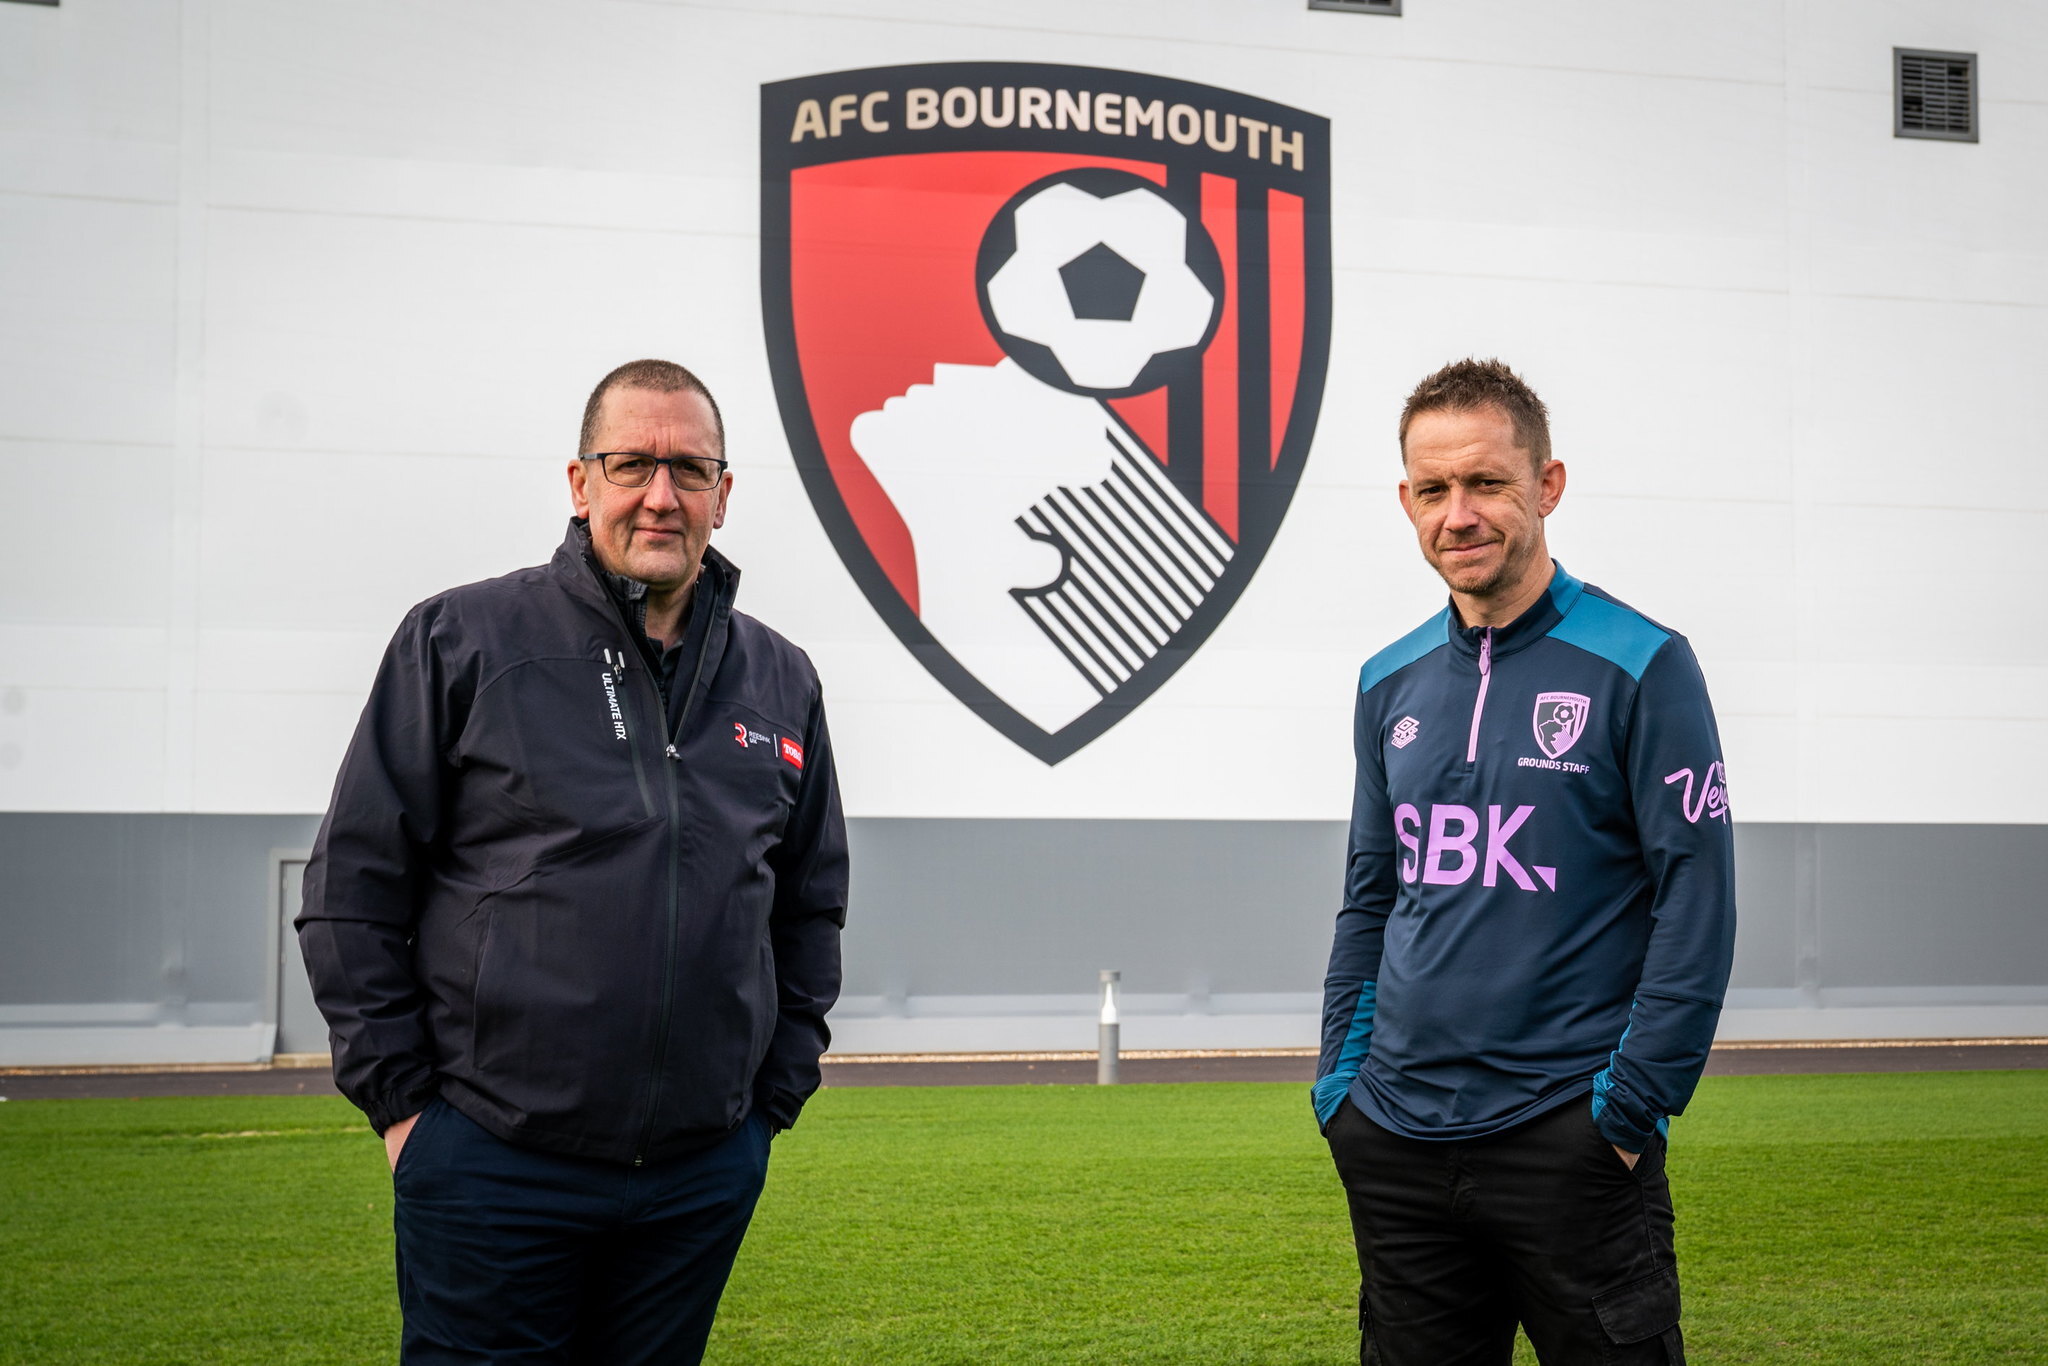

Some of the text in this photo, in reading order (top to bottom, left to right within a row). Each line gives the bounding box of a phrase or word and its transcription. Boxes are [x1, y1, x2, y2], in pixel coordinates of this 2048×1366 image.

[790, 86, 1304, 171] AFC BOURNEMOUTH
[601, 672, 627, 740] ULTIMATE HTX
[1550, 695, 1587, 704] BOURNEMOUTH
[1517, 757, 1591, 774] GROUNDS STAFF
